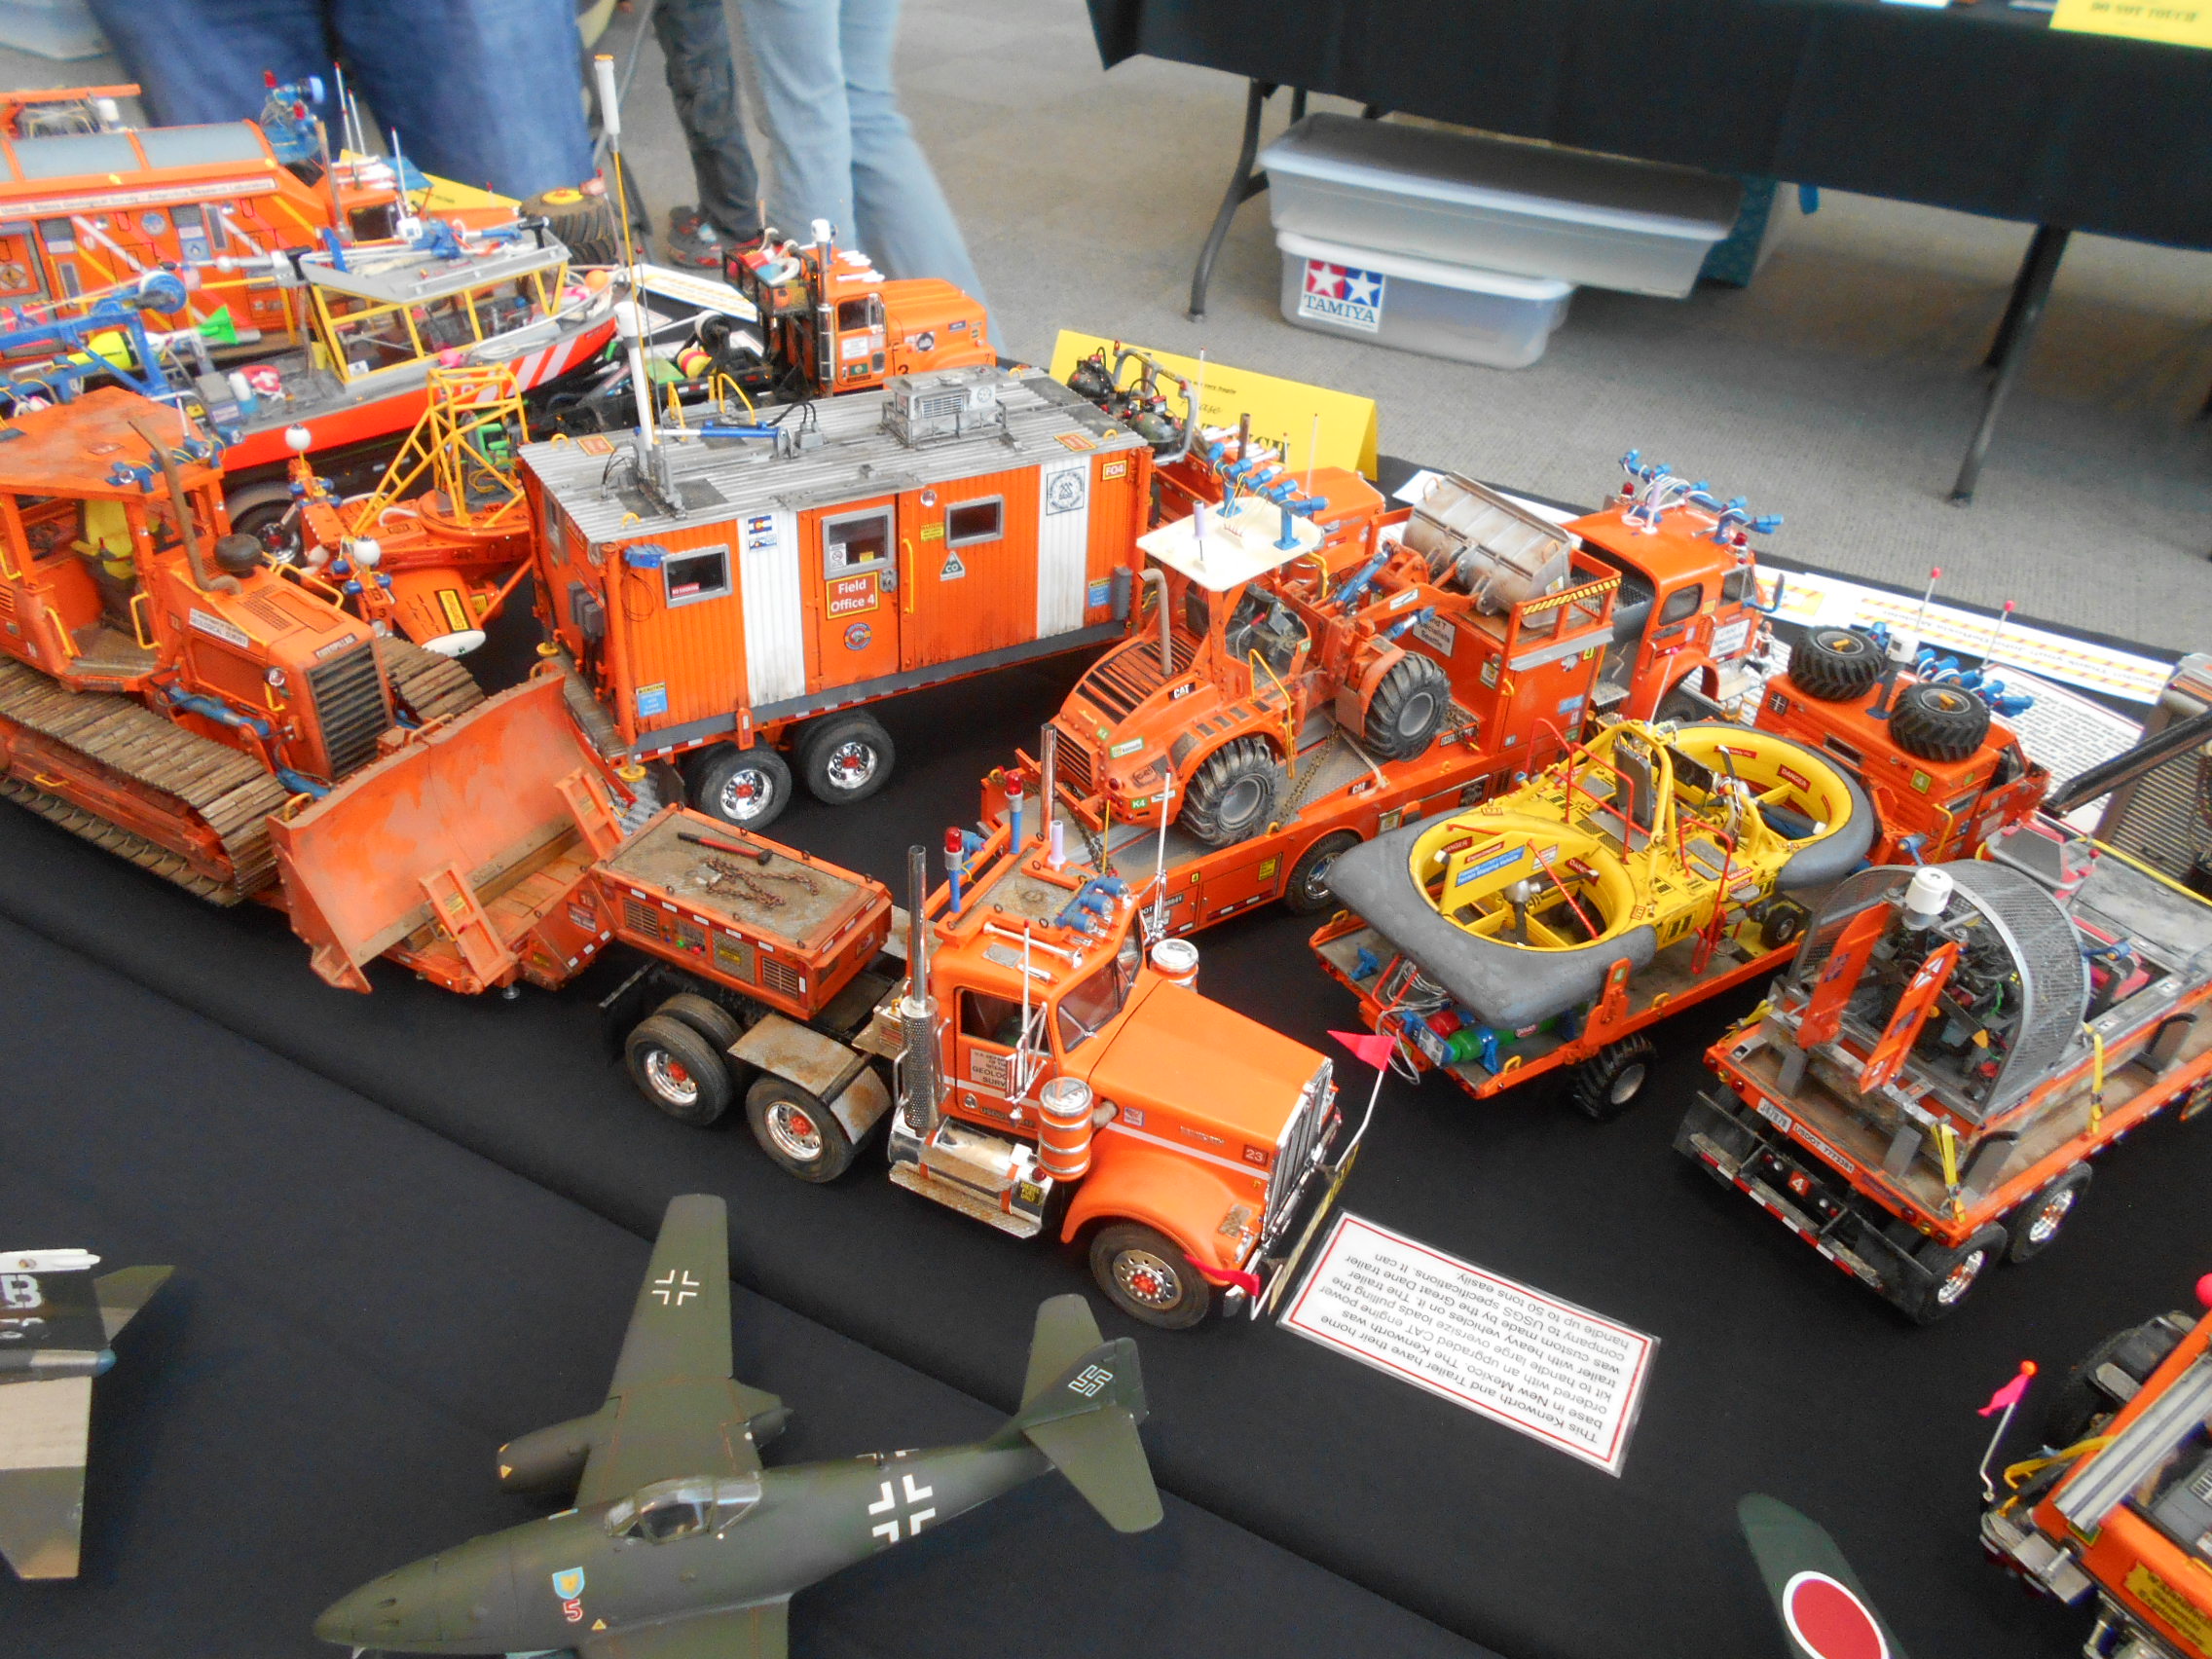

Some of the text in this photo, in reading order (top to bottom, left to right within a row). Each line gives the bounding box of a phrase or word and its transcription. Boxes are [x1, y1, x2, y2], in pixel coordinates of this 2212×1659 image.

[1304, 294, 1376, 324] TAMIYA
[1105, 464, 1124, 476] FO4
[945, 563, 958, 572] CO
[838, 578, 866, 595] Field
[830, 594, 876, 613] Office 4
[1173, 683, 1190, 700] CAT
[1352, 782, 1366, 794] CAT
[1782, 768, 1808, 789] DANGER
[1131, 799, 1146, 809] K4
[1793, 1124, 1821, 1147] USDOT
[1245, 1149, 1264, 1161] 23
[1791, 1178, 1804, 1193] 4
[1348, 1271, 1382, 1290] trailer
[2, 1274, 44, 1309] B
[1386, 1286, 1408, 1302] The
[1345, 1255, 1619, 1374] was custom made by the Great Dane trailer
[1375, 1253, 1624, 1360] company to USGS specifications. It can
[1429, 1304, 1445, 1314] on
[1456, 1273, 1628, 1349] handle up to 50 tons easily.
[1449, 1311, 1499, 1338] vehicles
[1332, 1276, 1611, 1402] kit to handle large oversize loads pulling the
[1504, 1335, 1543, 1358] heavy
[1319, 1286, 1606, 1414] ordered with an upgraded CAT engine power
[1342, 1310, 1603, 1429] base in New Mexico. The Kenworth was
[1547, 1354, 1572, 1370] with
[1320, 1315, 1597, 1443] This Kenworth and Trailer have their home
[1576, 1367, 1615, 1387] trailer
[563, 1600, 583, 1622] 5
